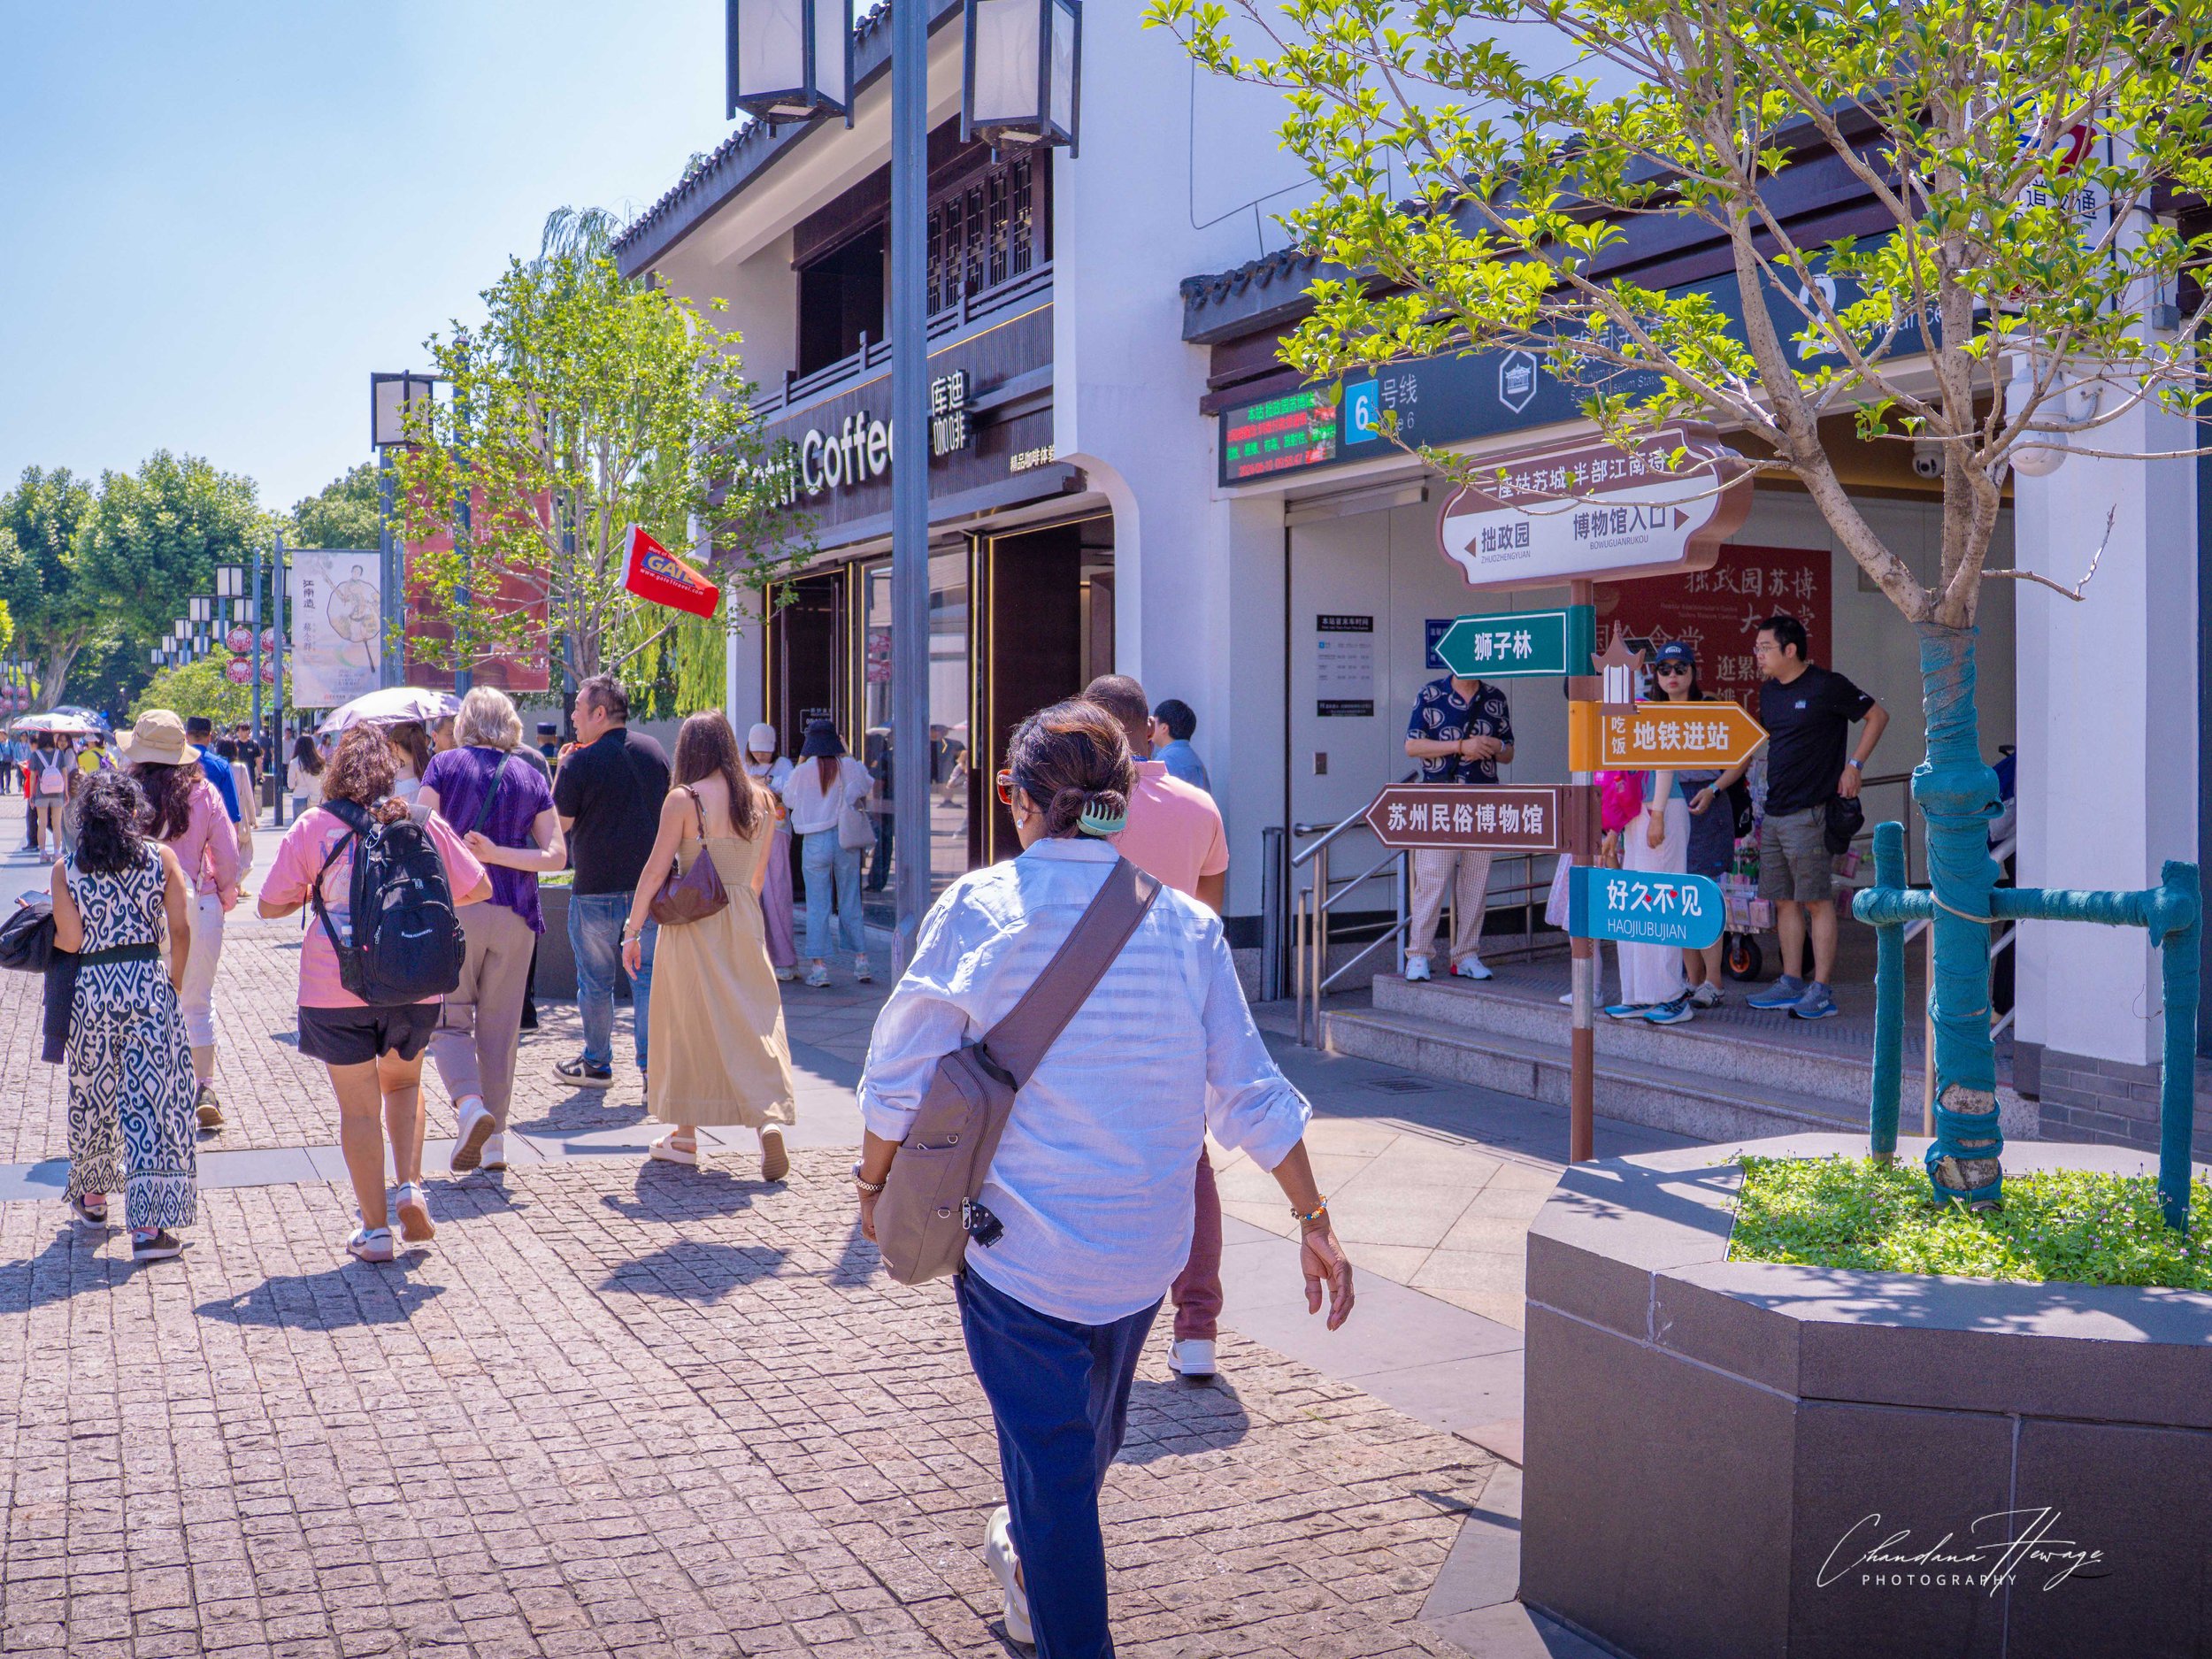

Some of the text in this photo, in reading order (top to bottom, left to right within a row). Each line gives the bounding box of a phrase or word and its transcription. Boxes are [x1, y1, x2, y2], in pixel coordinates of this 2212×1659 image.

[932, 369, 964, 418] 库迪
[1356, 395, 1370, 431] 6
[1381, 374, 1418, 409] 号线
[933, 410, 966, 456] 咖啡
[802, 410, 893, 496] Coffe
[1481, 506, 1666, 553] 拙政园 博物馆入口
[1590, 534, 1649, 549] BOWUGUANRUKOU
[1481, 550, 1531, 564] ZHUOZHENGYUAN
[1474, 630, 1532, 661] 狮子林
[1611, 716, 1626, 755] 吃饭
[1632, 720, 1730, 750] 地铁进站
[1387, 803, 1543, 834] 苏州民俗博物馆
[1607, 879, 1702, 917] 好久不见
[1608, 918, 1686, 941] HAOJIUBUJIAN
